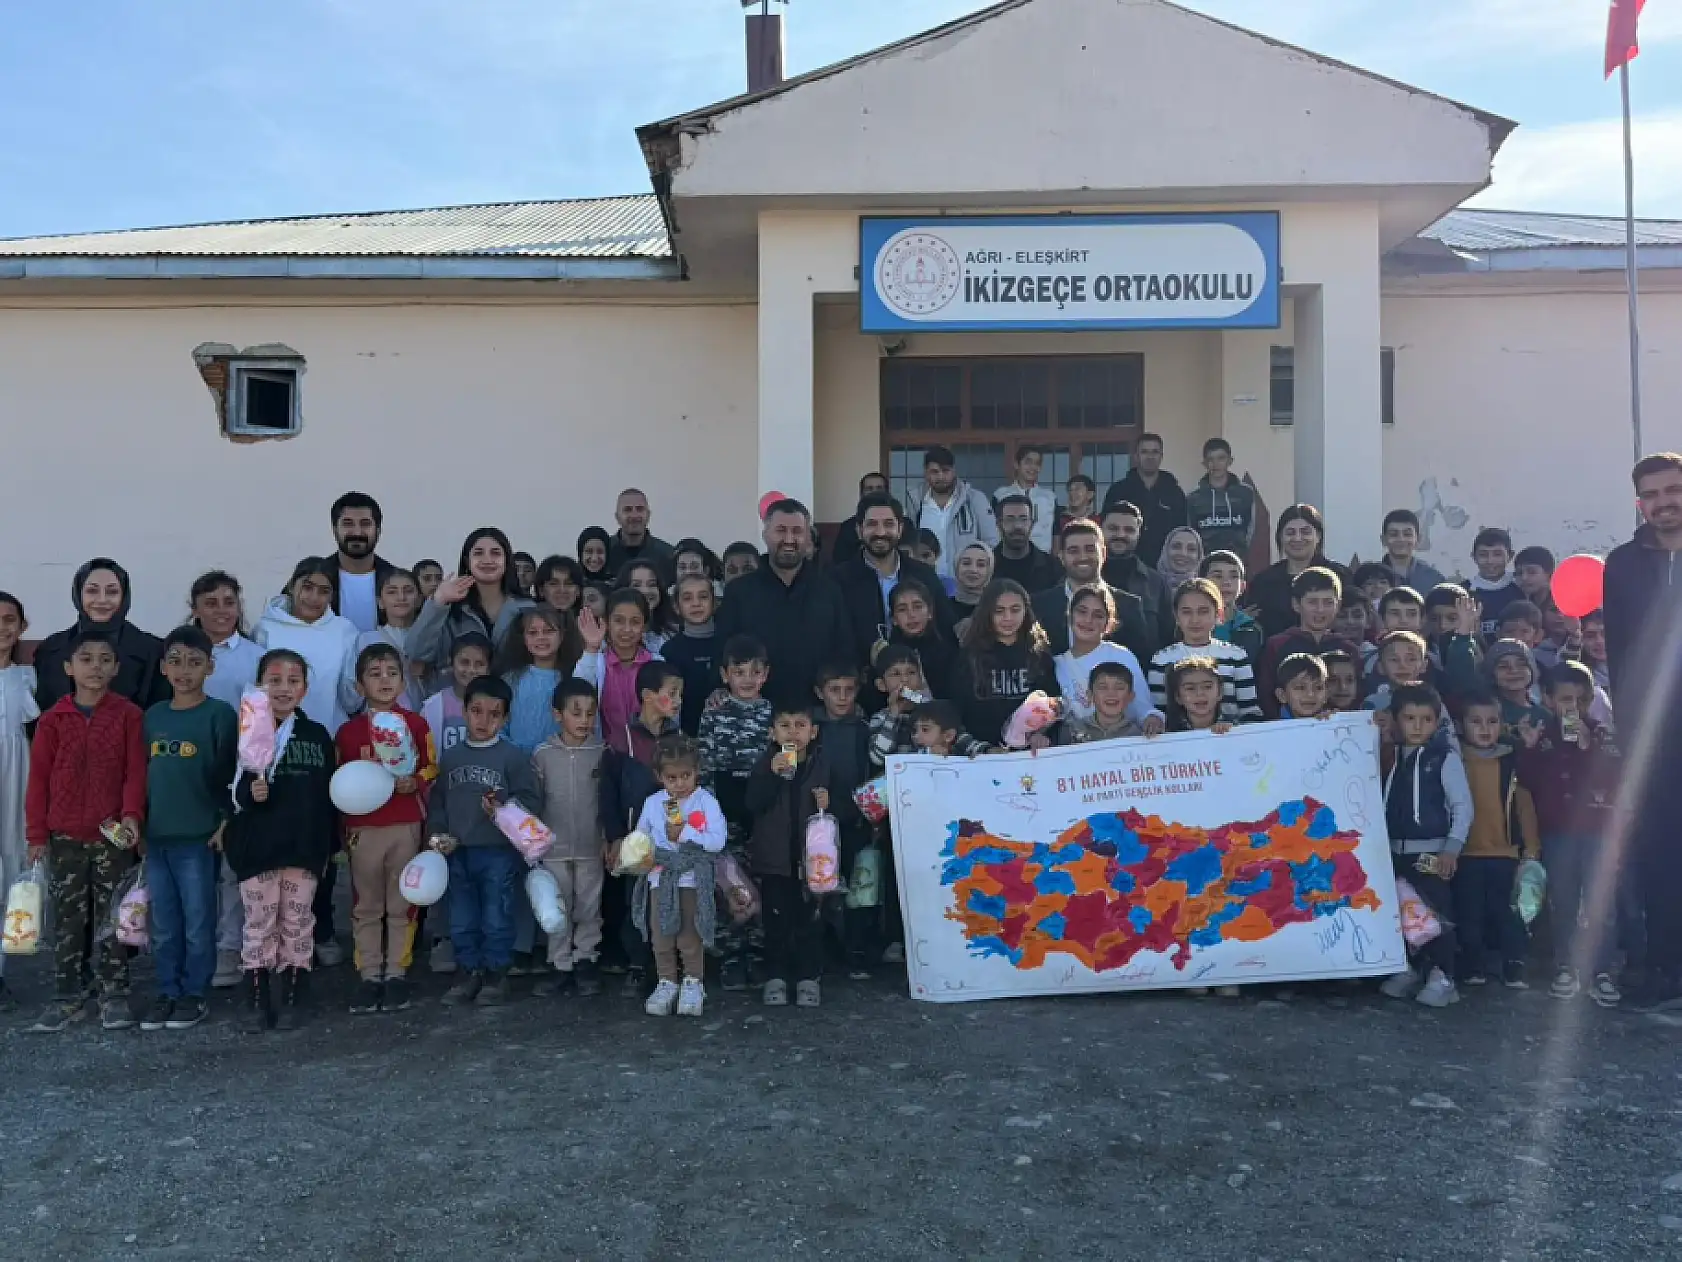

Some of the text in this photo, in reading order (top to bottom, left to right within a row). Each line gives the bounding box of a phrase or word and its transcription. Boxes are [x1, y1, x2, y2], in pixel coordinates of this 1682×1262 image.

[965, 248, 1002, 264] AĞRI
[1015, 248, 1089, 266] ELEŞKİRT
[964, 268, 1253, 310] İKİZGEÇE ORTAOKULU
[991, 668, 1030, 694] LIKE
[1057, 777, 1076, 793] 81
[1080, 769, 1127, 790] HAYAL
[1130, 764, 1156, 783] BİR
[1159, 759, 1223, 780] TÜRKİYE
